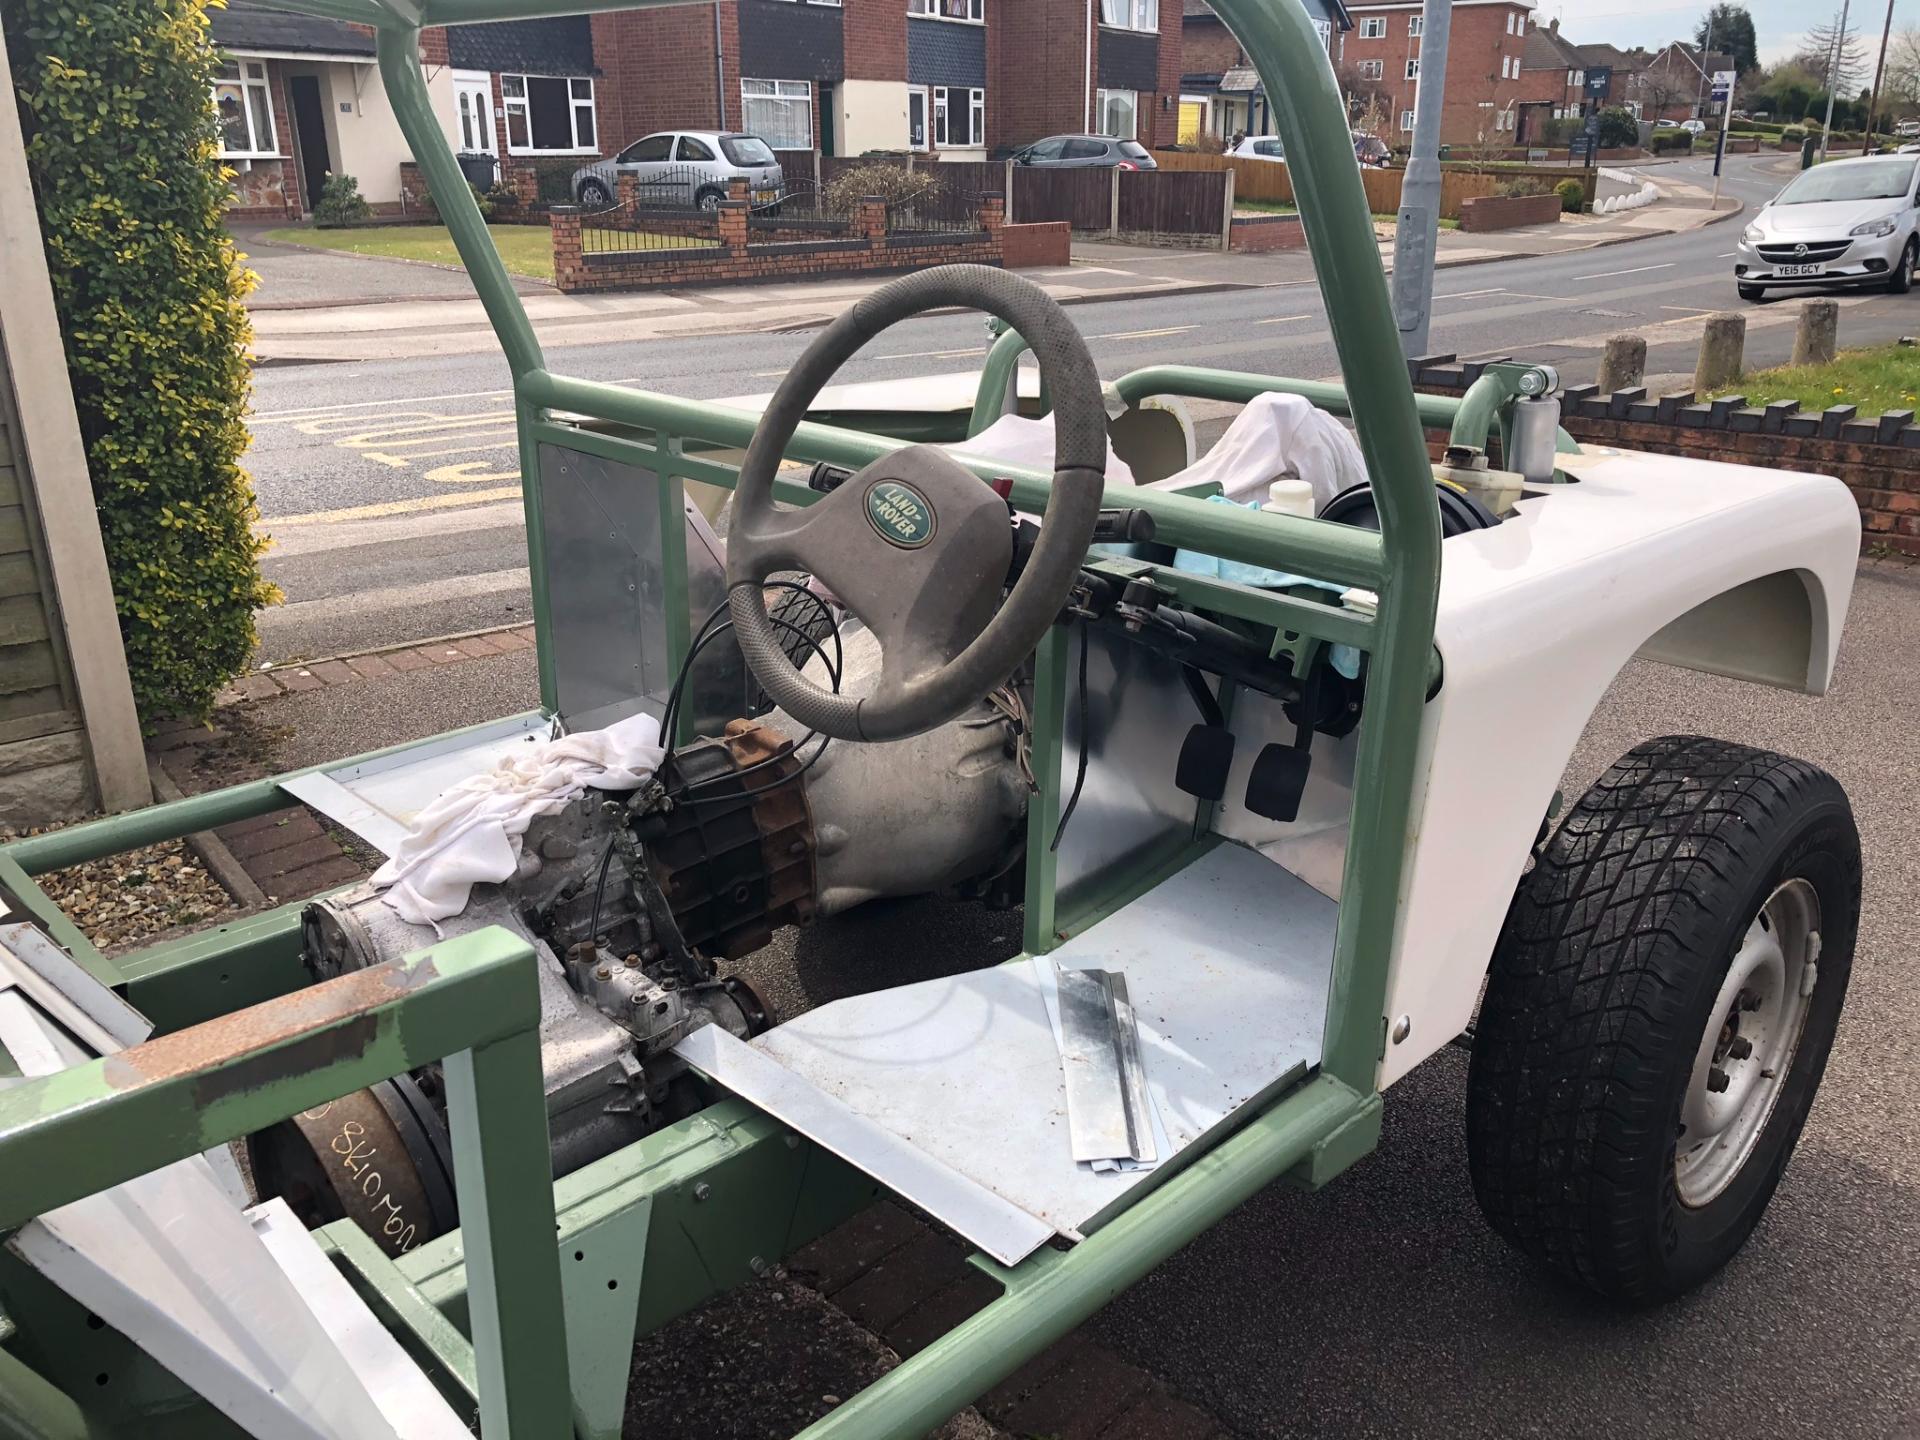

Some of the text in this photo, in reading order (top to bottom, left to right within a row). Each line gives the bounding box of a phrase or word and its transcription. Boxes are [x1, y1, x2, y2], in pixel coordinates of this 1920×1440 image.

[1778, 264, 1820, 276] YE15 GCY
[884, 489, 918, 517] LAND
[876, 502, 917, 538] ROVER
